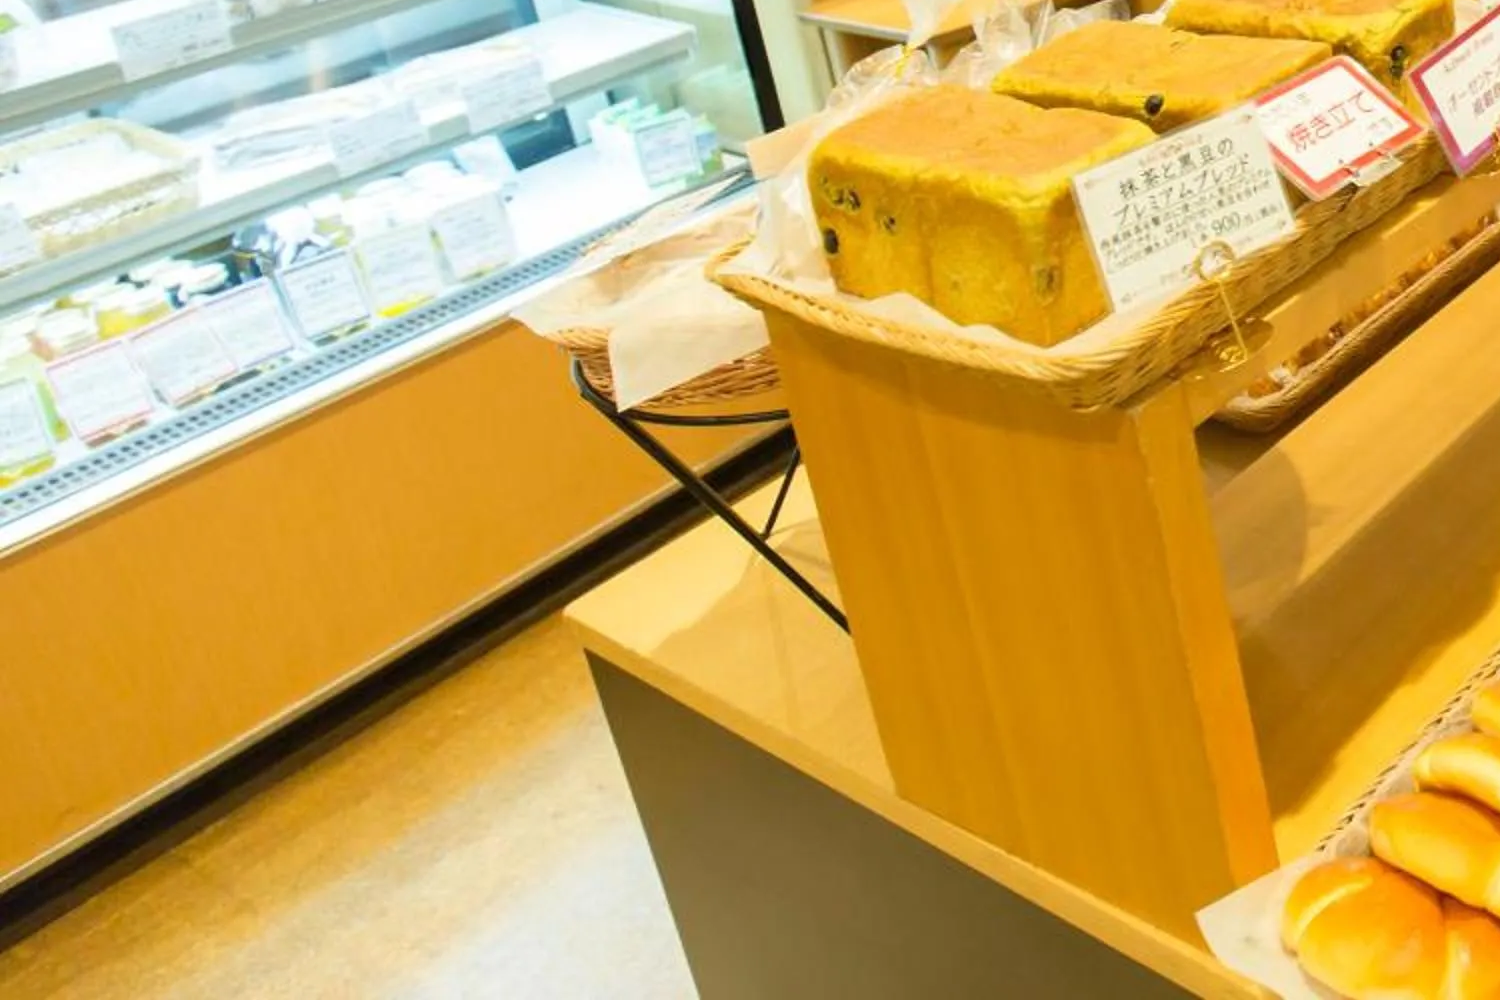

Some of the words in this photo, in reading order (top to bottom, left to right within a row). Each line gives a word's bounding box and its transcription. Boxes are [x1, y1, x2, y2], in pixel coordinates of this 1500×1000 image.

[1282, 86, 1381, 155] 焼き立て
[1110, 150, 1254, 229] プレミアムブレッド
[1116, 133, 1236, 201] 抹茶と黒豆の
